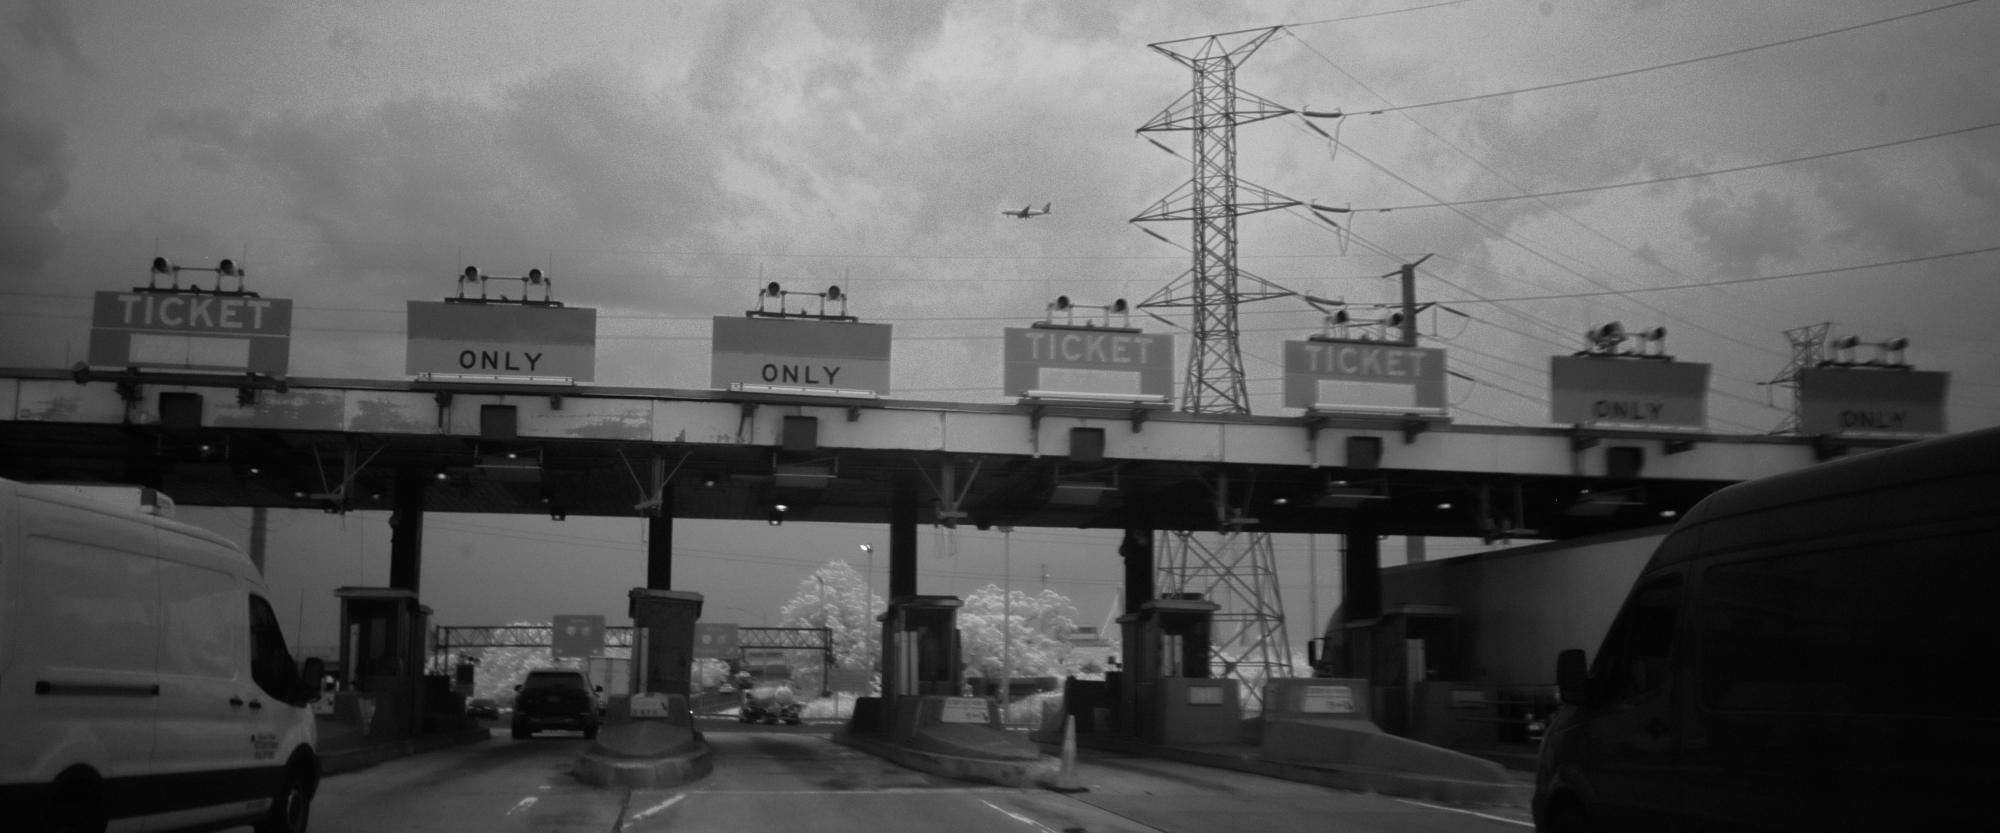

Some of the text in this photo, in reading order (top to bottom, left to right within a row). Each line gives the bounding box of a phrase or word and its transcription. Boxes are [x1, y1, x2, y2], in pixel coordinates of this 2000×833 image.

[118, 294, 271, 329] TICKET
[1025, 332, 1154, 364] TICKET
[459, 349, 543, 371] ONLY
[1304, 345, 1427, 377] TICKET
[761, 363, 841, 385] ONLY
[1592, 400, 1665, 421] ONLY
[1838, 410, 1908, 429] ONLY
